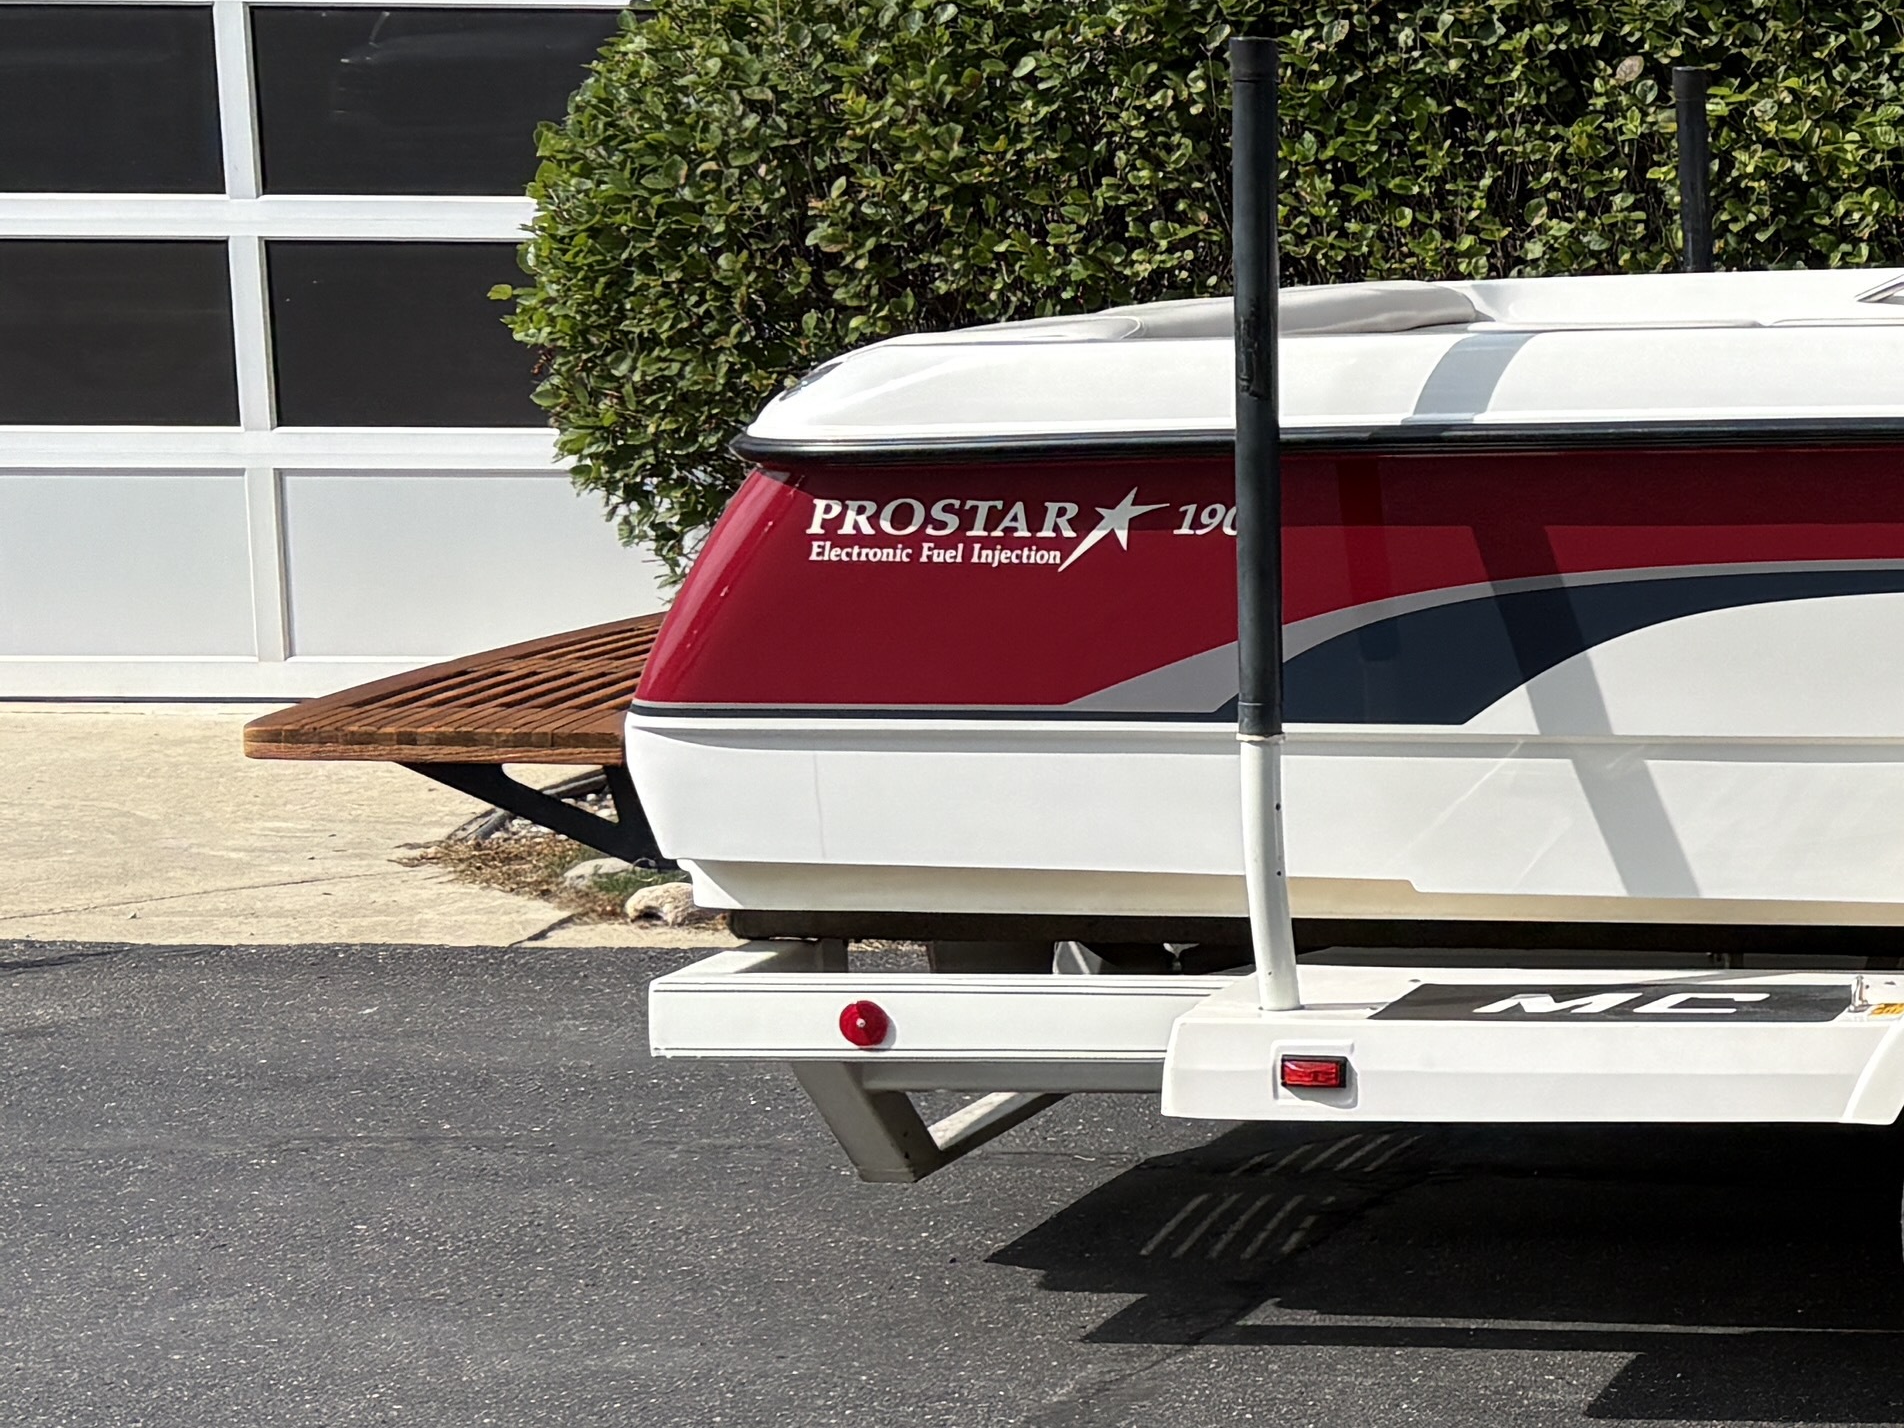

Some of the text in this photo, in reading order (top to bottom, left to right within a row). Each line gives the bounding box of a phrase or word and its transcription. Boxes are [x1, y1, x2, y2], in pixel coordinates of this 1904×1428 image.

[805, 497, 1079, 538] PROSTAR
[808, 541, 1062, 568] Electronic Fuel Injection
[1472, 992, 1770, 1013] MC
